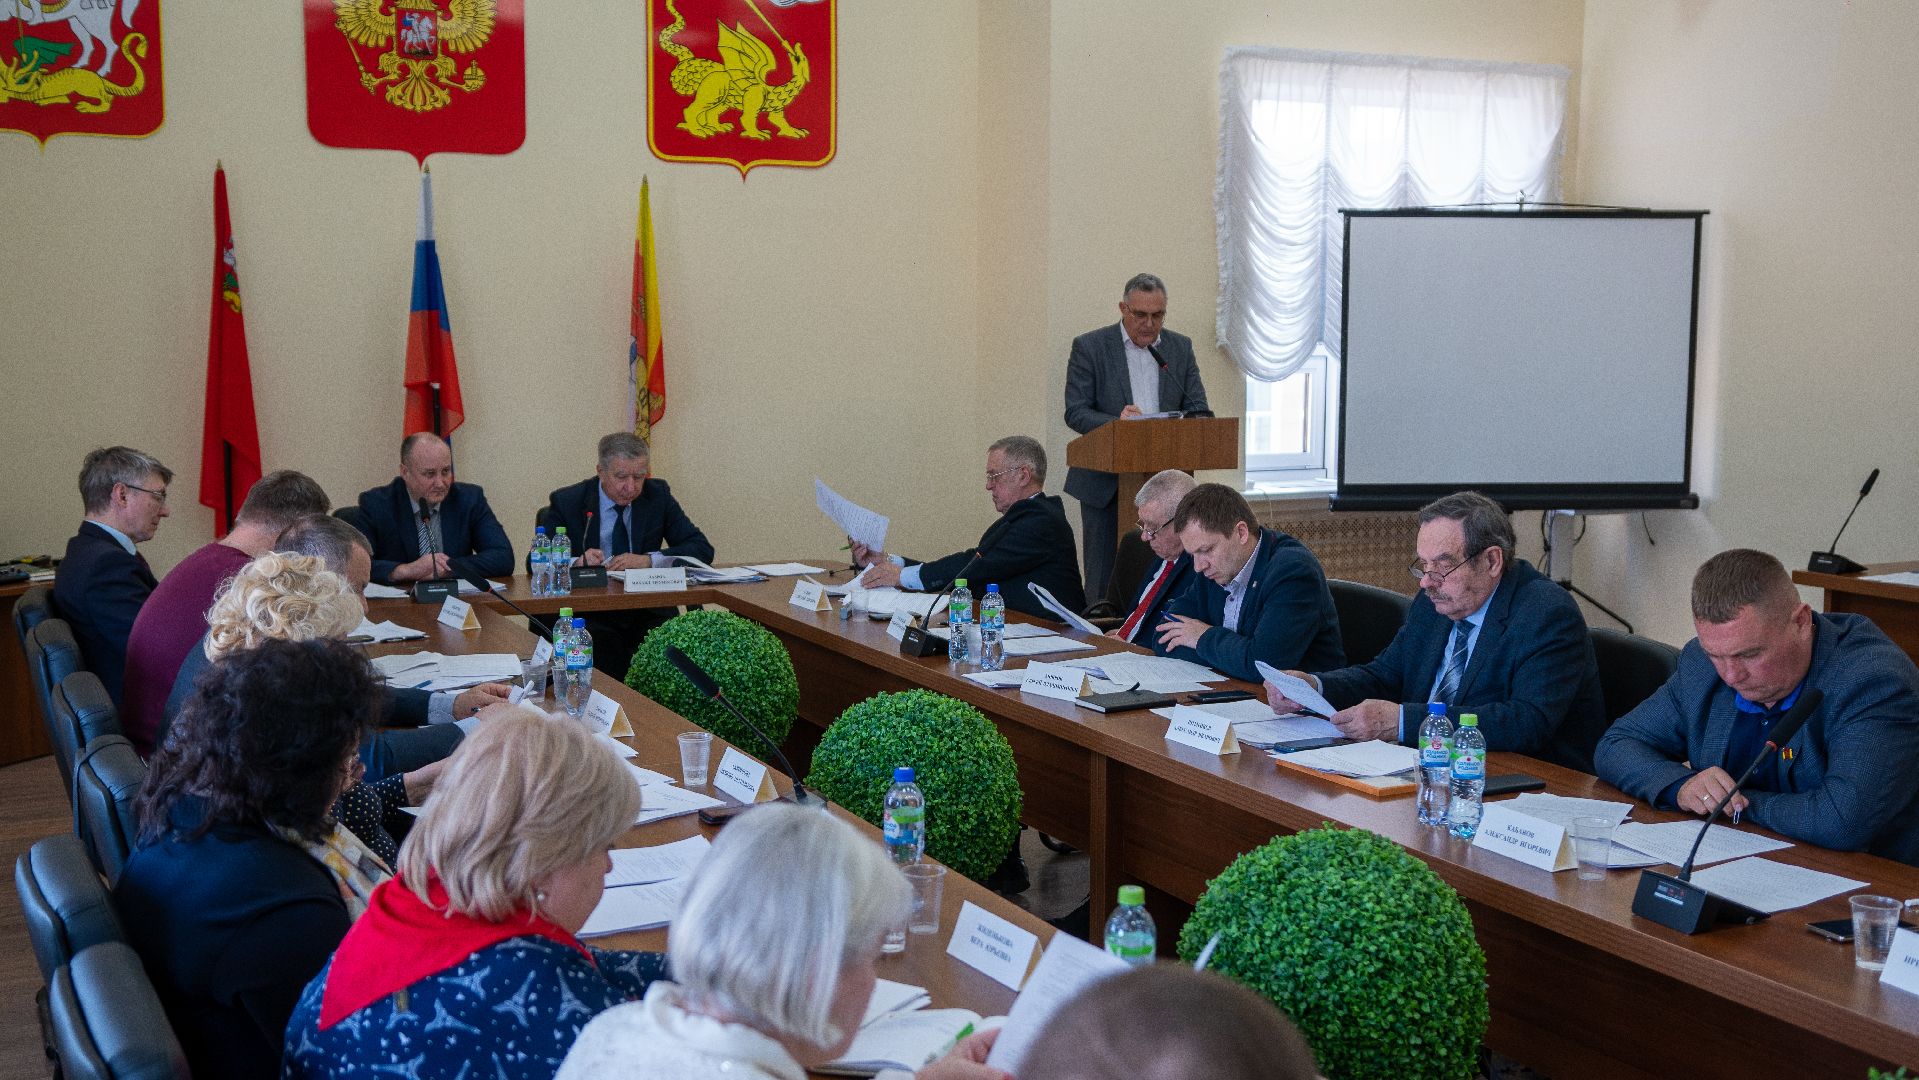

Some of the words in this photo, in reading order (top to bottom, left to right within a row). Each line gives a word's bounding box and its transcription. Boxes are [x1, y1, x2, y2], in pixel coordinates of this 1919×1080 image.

[1506, 824, 1536, 839] КАБАНОВ
[1484, 829, 1518, 845] АЛЕКСАНДР
[1519, 840, 1552, 857] ИГОРЕВИЧ
